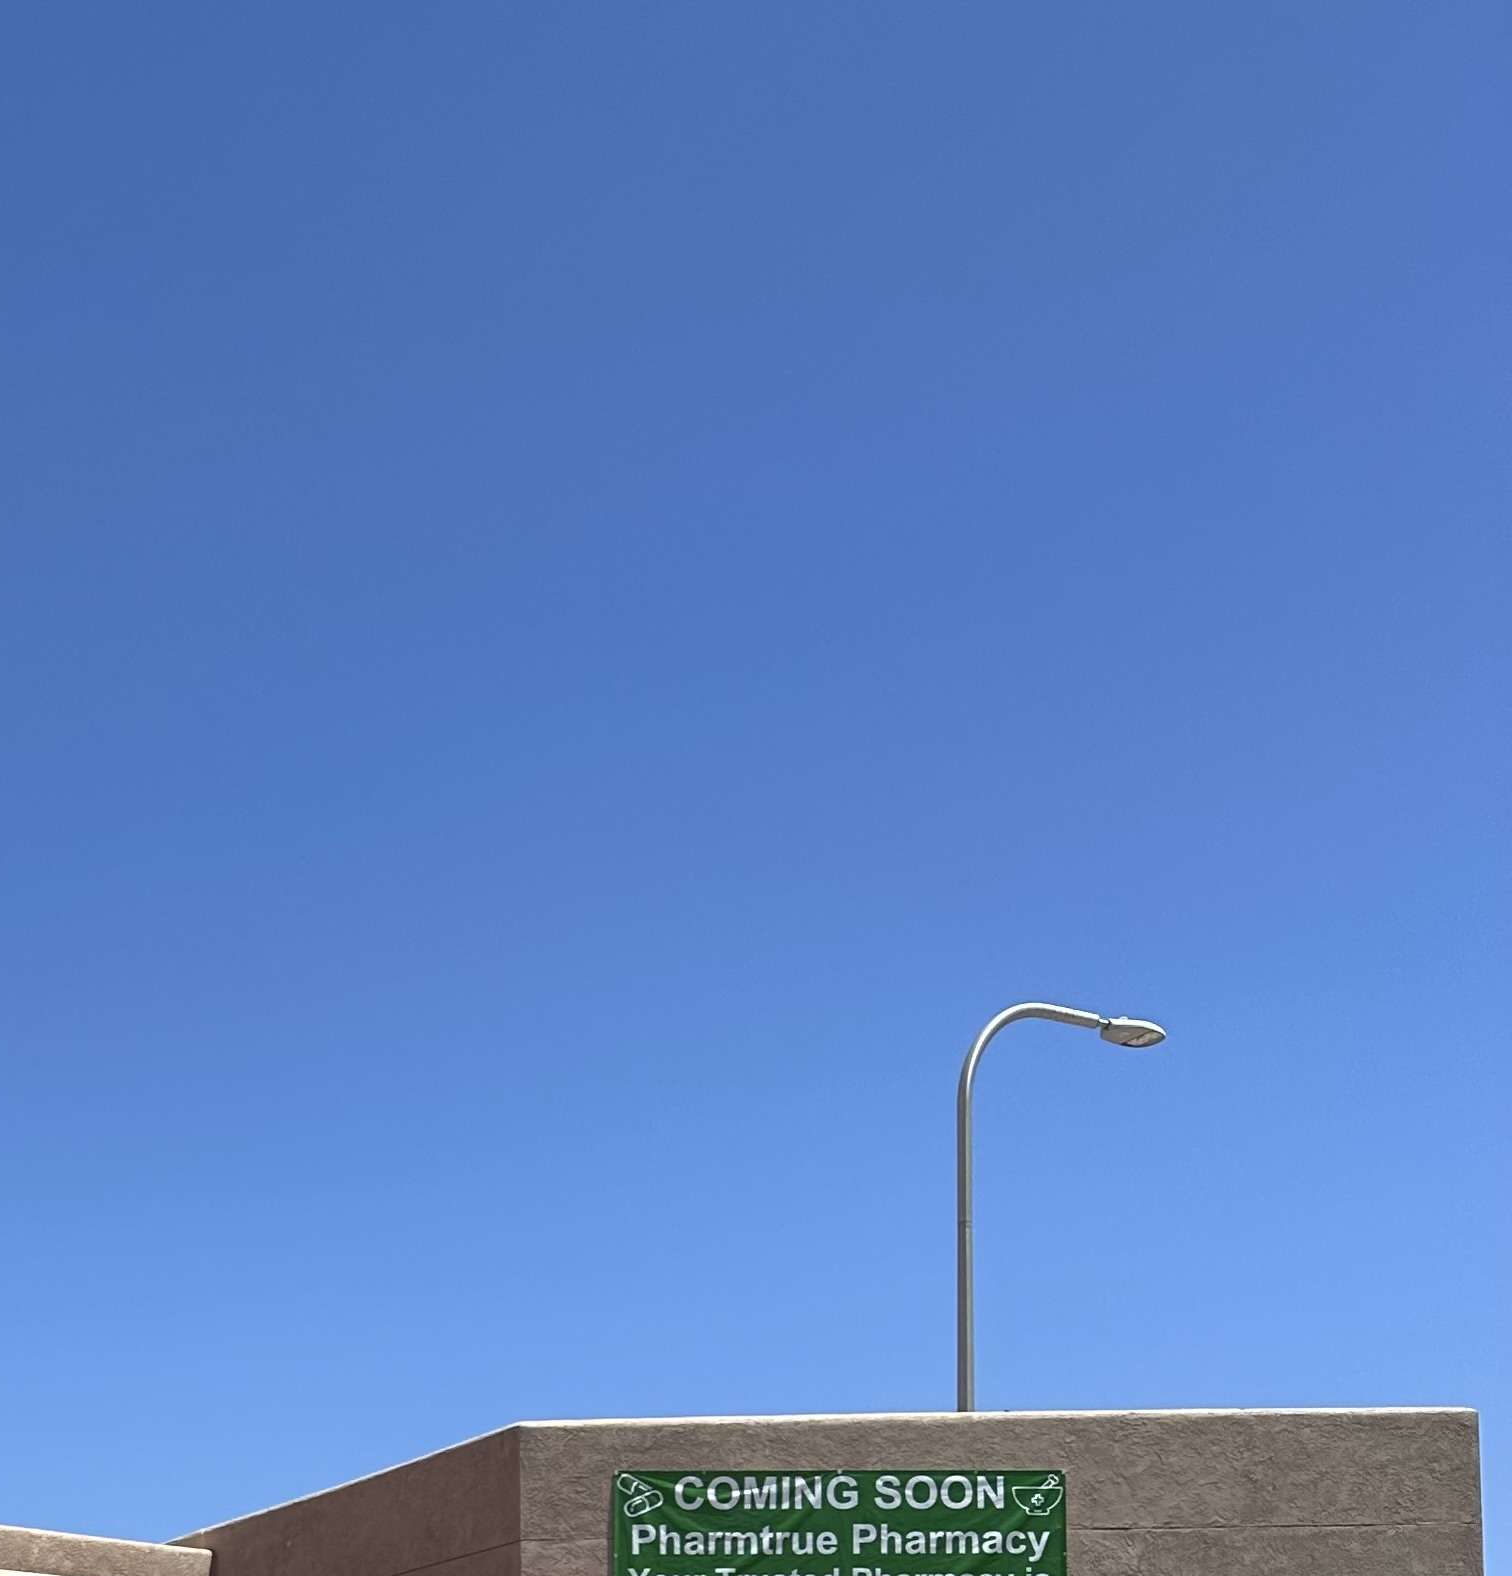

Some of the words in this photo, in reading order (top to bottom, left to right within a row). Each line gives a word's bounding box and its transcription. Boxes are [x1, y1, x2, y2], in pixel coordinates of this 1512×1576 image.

[674, 1475, 859, 1510] COMING
[874, 1474, 1006, 1510] SOON
[631, 1523, 838, 1556] Pharmtrue
[852, 1523, 1050, 1562] Pharmacy
